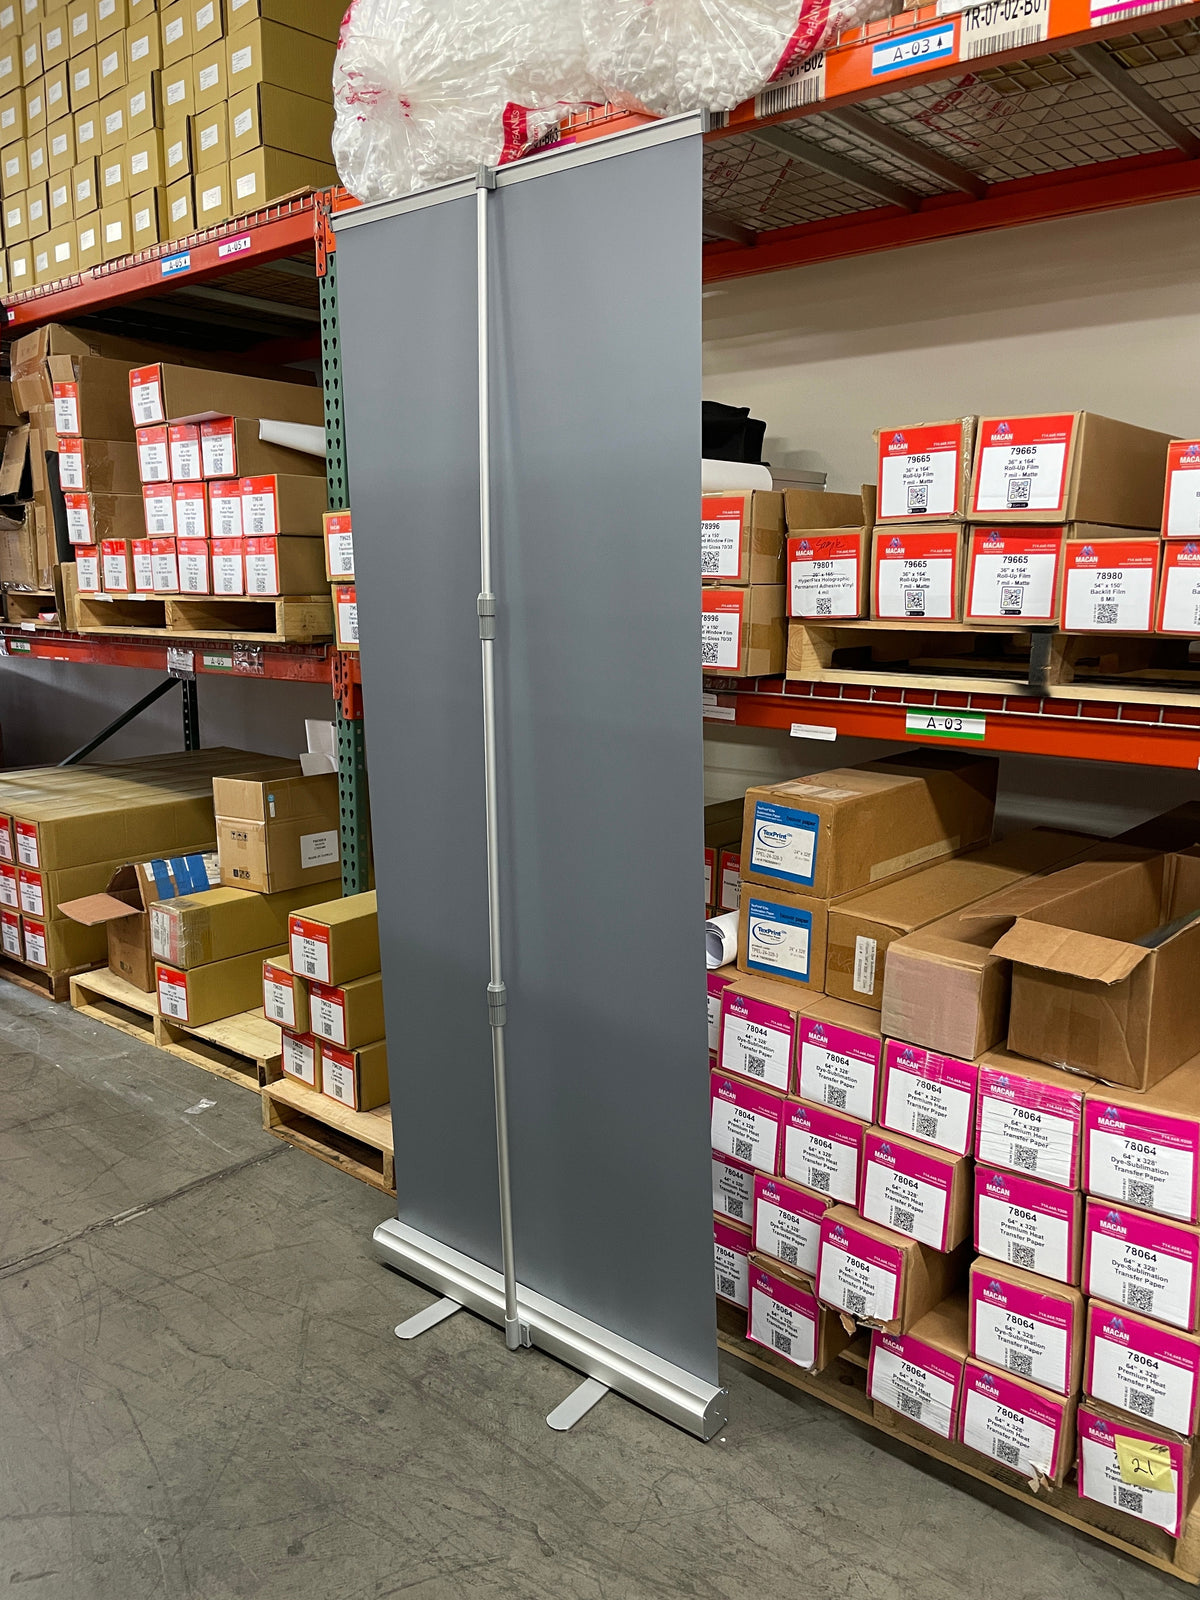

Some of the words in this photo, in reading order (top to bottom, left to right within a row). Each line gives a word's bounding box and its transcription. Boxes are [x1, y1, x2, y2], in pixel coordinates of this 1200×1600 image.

[893, 38, 930, 62] A-03
[991, 433, 1013, 441] MACAN
[1011, 446, 1036, 455] 79665
[908, 455, 930, 463] 79665
[926, 717, 962, 730] A-03
[731, 1005, 748, 1014] MACAN
[746, 1024, 767, 1036] 78044
[809, 1032, 828, 1042] MACAN
[736, 1036, 774, 1053] Dye-Sublimation
[738, 1043, 758, 1053] Transfer
[759, 1049, 773, 1058] Paper
[827, 1054, 849, 1066] 78064
[897, 1057, 920, 1069] MACAN
[815, 1066, 858, 1083] Dye-Sublimation
[817, 1073, 839, 1084] Transfer
[840, 1080, 856, 1089] Paper
[719, 1089, 736, 1099] MACAN
[916, 1080, 941, 1094] 78064
[991, 1086, 1014, 1097] MACAN
[907, 1094, 932, 1106] Premium
[934, 1102, 948, 1110] Heat
[735, 1109, 755, 1121] 78044
[905, 1101, 929, 1112] Transfer
[931, 1108, 948, 1118] Paper
[1013, 1108, 1041, 1123] 78064
[792, 1116, 810, 1126] MACAN
[1098, 1118, 1125, 1129] MACAN
[1003, 1125, 1032, 1136] Premium
[808, 1136, 832, 1148] 78064
[1002, 1131, 1029, 1143] Transfer
[1030, 1138, 1049, 1148] Paper
[1125, 1141, 1156, 1155] 78064
[875, 1152, 895, 1162] MACAN
[1111, 1157, 1169, 1174] Dye-Sublimation
[725, 1168, 744, 1180] 78044
[894, 1174, 918, 1188] 78064
[1114, 1166, 1144, 1177] Transfer
[1145, 1173, 1165, 1182] Paper
[763, 1190, 780, 1200] MACAN
[885, 1188, 909, 1201] Premium
[911, 1198, 924, 1206] Heat
[987, 1185, 1009, 1195] MACAN
[884, 1194, 906, 1206] Transfer
[908, 1202, 924, 1212] Paper
[778, 1210, 799, 1223] 78064
[1009, 1208, 1036, 1221] 78064
[1000, 1223, 1028, 1235] Premium
[1100, 1222, 1126, 1233] MACAN
[829, 1234, 848, 1245] MACAN
[999, 1229, 1025, 1241] Transfer
[1026, 1237, 1046, 1246] Paper
[715, 1247, 734, 1258] 78044
[1126, 1246, 1156, 1261] 78064
[845, 1256, 869, 1272] 78064
[1110, 1260, 1168, 1282] Dye-Sublimation
[1113, 1270, 1142, 1282] Transfer
[1145, 1278, 1164, 1289] Paper
[984, 1291, 1007, 1302] MACAN
[771, 1302, 792, 1316] 78064
[1007, 1315, 1034, 1329] 78064
[994, 1328, 1046, 1349] Dye-Sublimation
[1103, 1328, 1129, 1340] MACAN
[883, 1339, 904, 1350] MACAN
[996, 1335, 1022, 1348] Transfer
[1024, 1344, 1043, 1355] Paper
[1128, 1352, 1158, 1368] 78064
[900, 1362, 926, 1379] 78064
[1116, 1374, 1144, 1388] Transfer
[1146, 1384, 1167, 1395] Paper
[1117, 1368, 1148, 1382] Premium
[1150, 1378, 1167, 1388] Heat
[976, 1381, 999, 1394] MACAN
[997, 1407, 1024, 1424] 78064
[986, 1425, 1011, 1440] Transfer
[1012, 1436, 1031, 1448] Paper
[987, 1419, 1014, 1435] Premium
[1016, 1431, 1031, 1442] Heat
[1089, 1428, 1115, 1442] MACAN
[1132, 1458, 1154, 1476] 21
